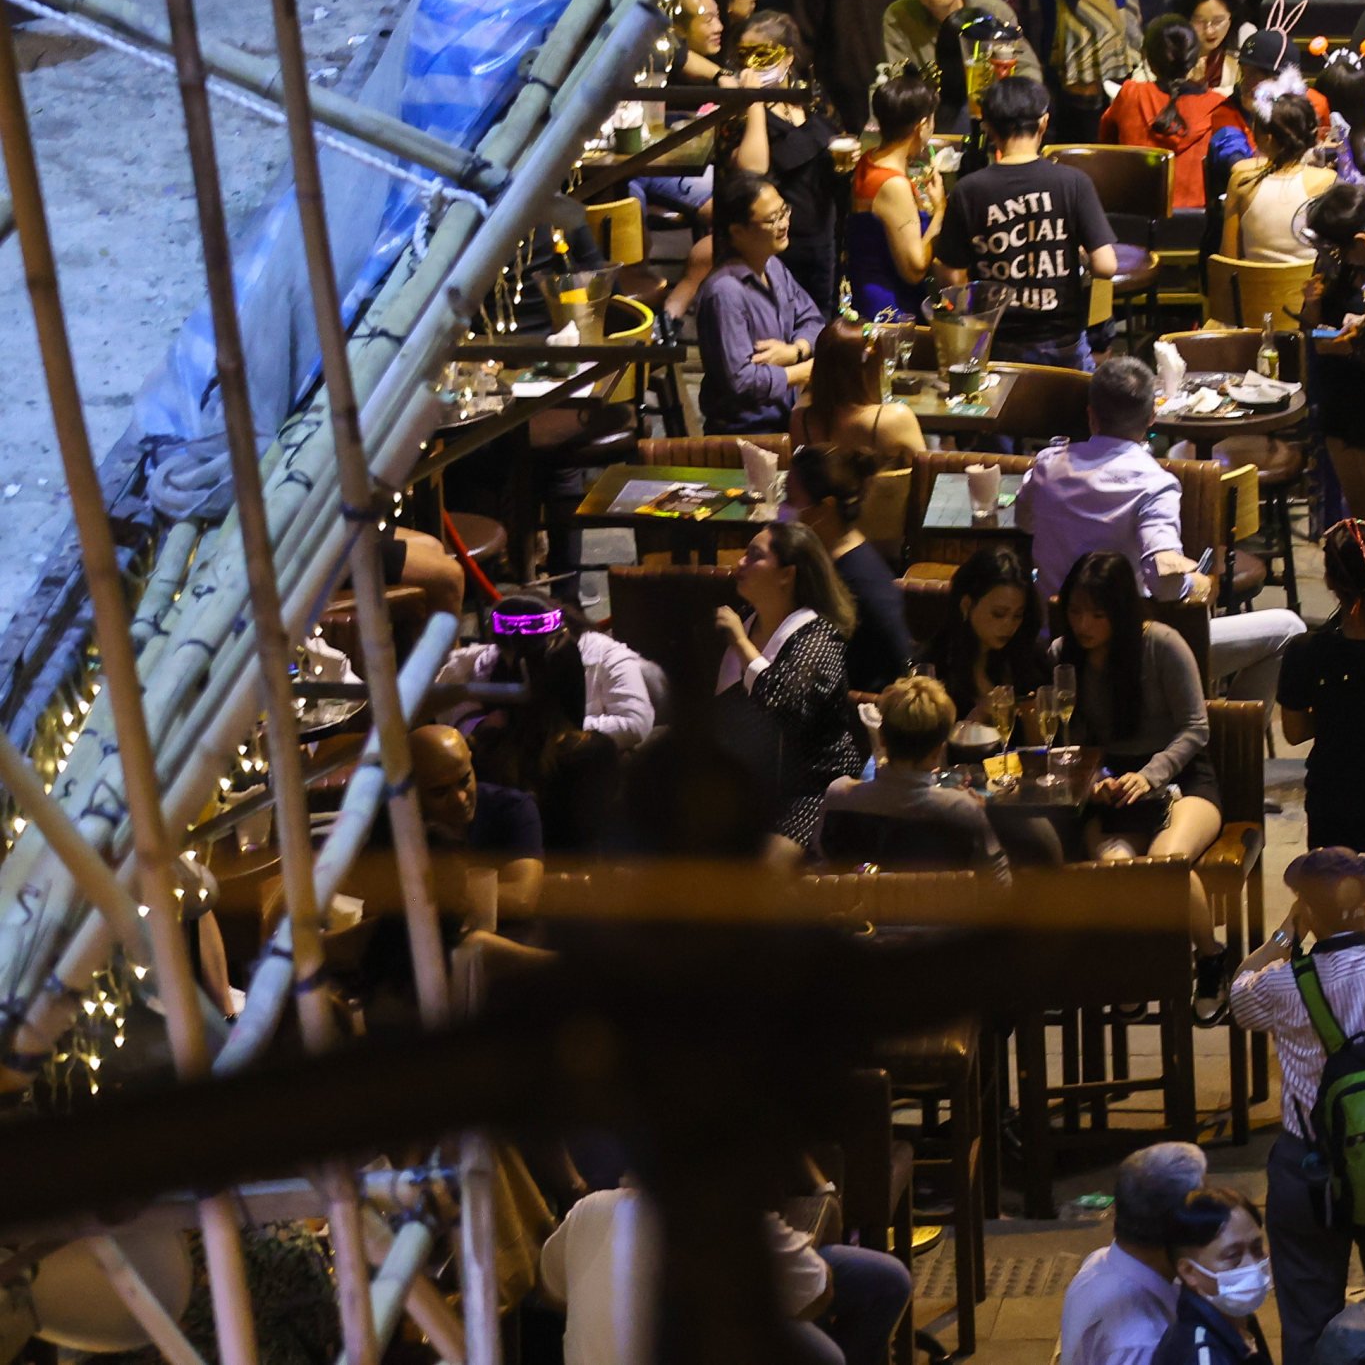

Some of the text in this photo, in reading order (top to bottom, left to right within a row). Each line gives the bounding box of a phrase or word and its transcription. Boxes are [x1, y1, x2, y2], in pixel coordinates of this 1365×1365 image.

[986, 191, 1053, 227] ANTI
[971, 218, 1068, 255] SOCIAL
[977, 249, 1071, 280] SOCIAL
[988, 287, 1058, 311] CLUB
